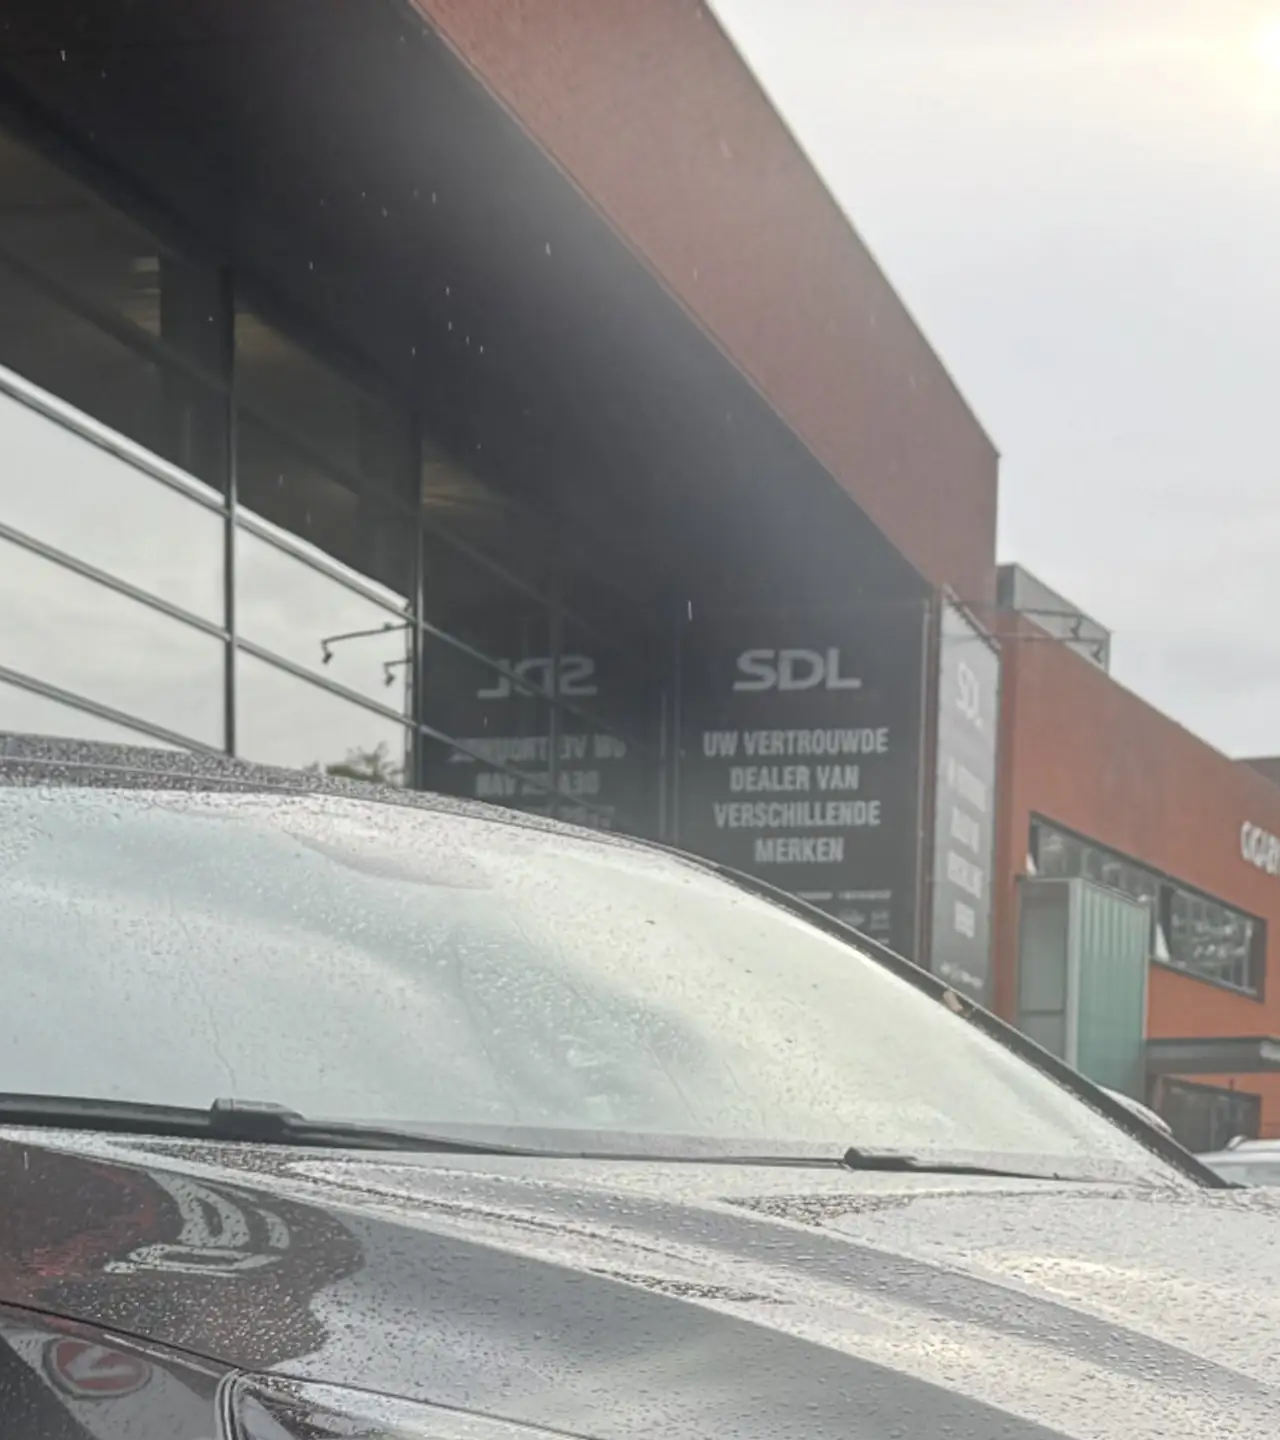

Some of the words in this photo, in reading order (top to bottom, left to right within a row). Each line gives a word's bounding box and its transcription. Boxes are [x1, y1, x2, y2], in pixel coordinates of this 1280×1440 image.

[733, 648, 861, 690] SDL
[703, 731, 738, 756] UW
[744, 727, 889, 755] VERTROUWDE
[730, 765, 810, 792] DEALER
[816, 764, 860, 790] VAN
[713, 801, 882, 828] VERSCHILLENDE
[754, 837, 844, 863] MERKEN
